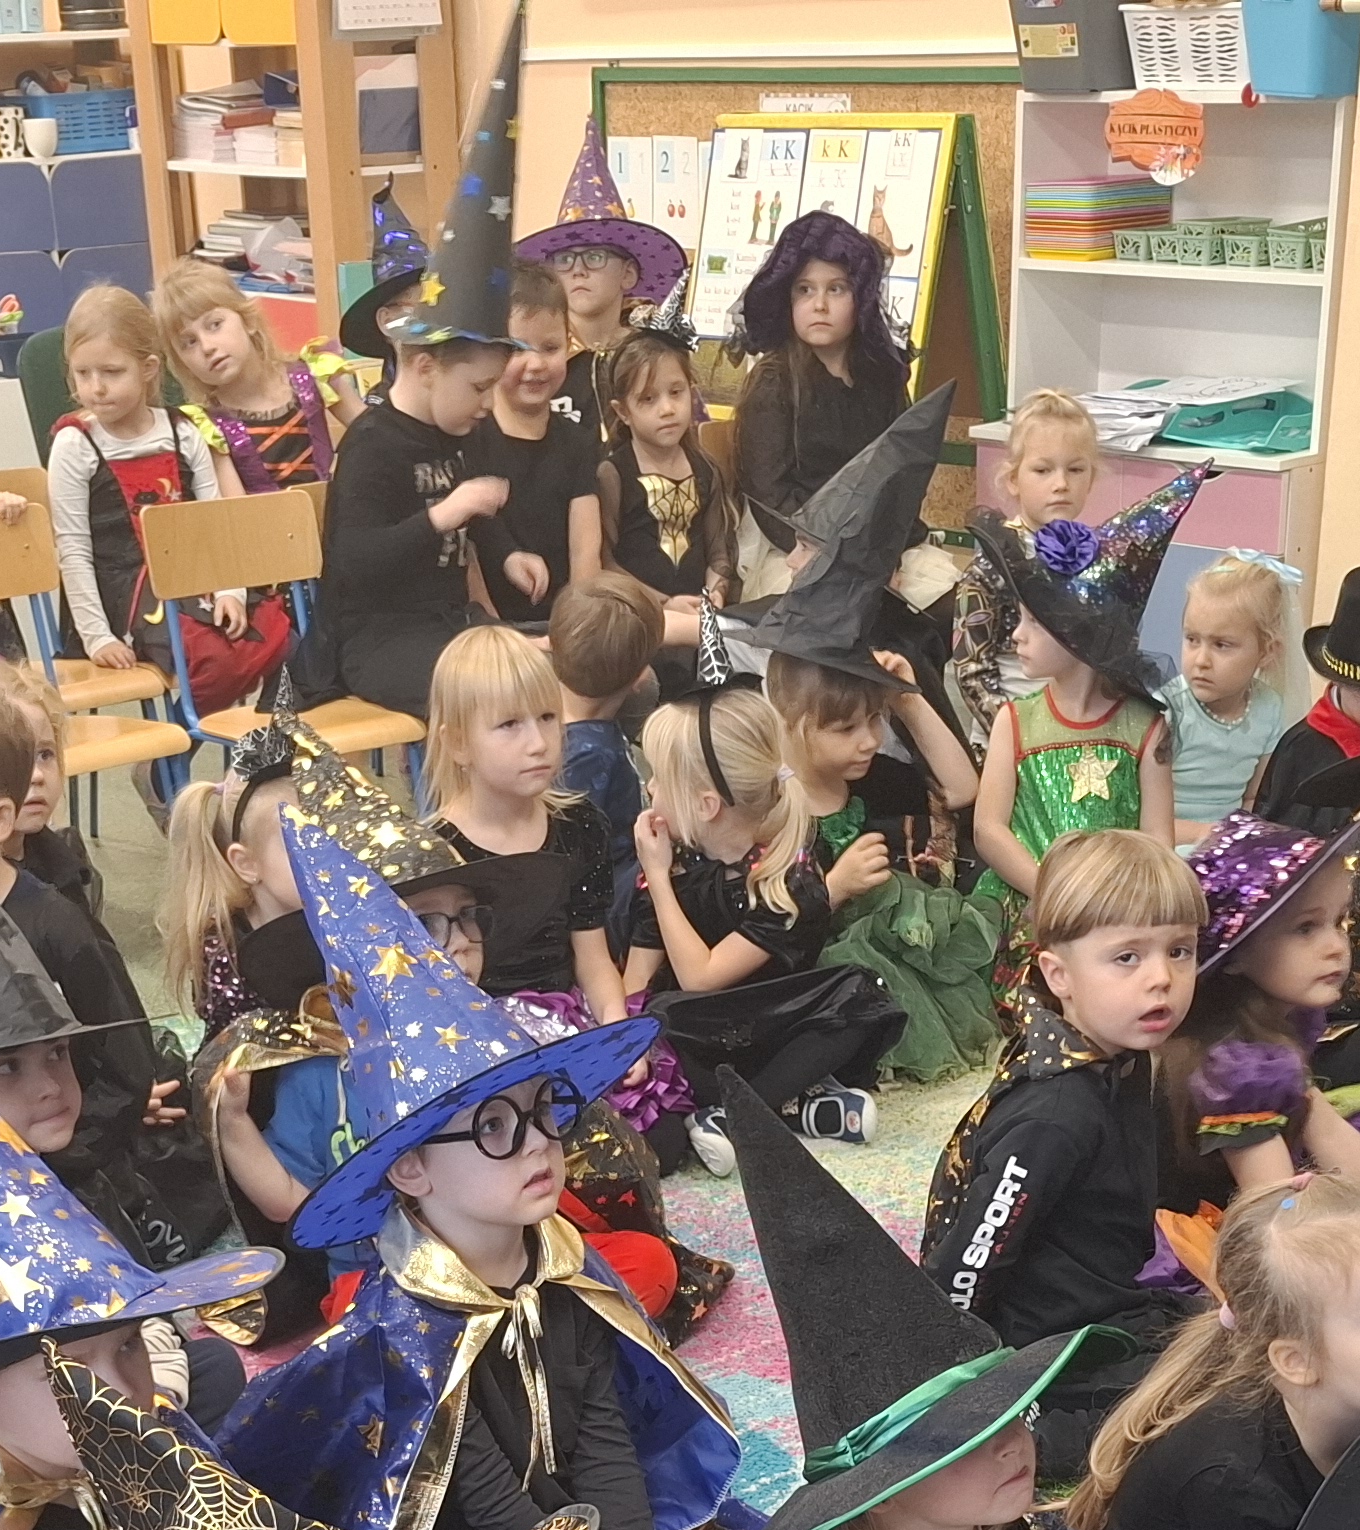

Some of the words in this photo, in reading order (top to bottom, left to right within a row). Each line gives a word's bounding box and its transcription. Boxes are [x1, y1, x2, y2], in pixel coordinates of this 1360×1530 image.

[1140, 124, 1199, 137] PLASTYCZNY
[962, 1155, 1028, 1269] SPORT
[950, 1270, 978, 1311] OLO
